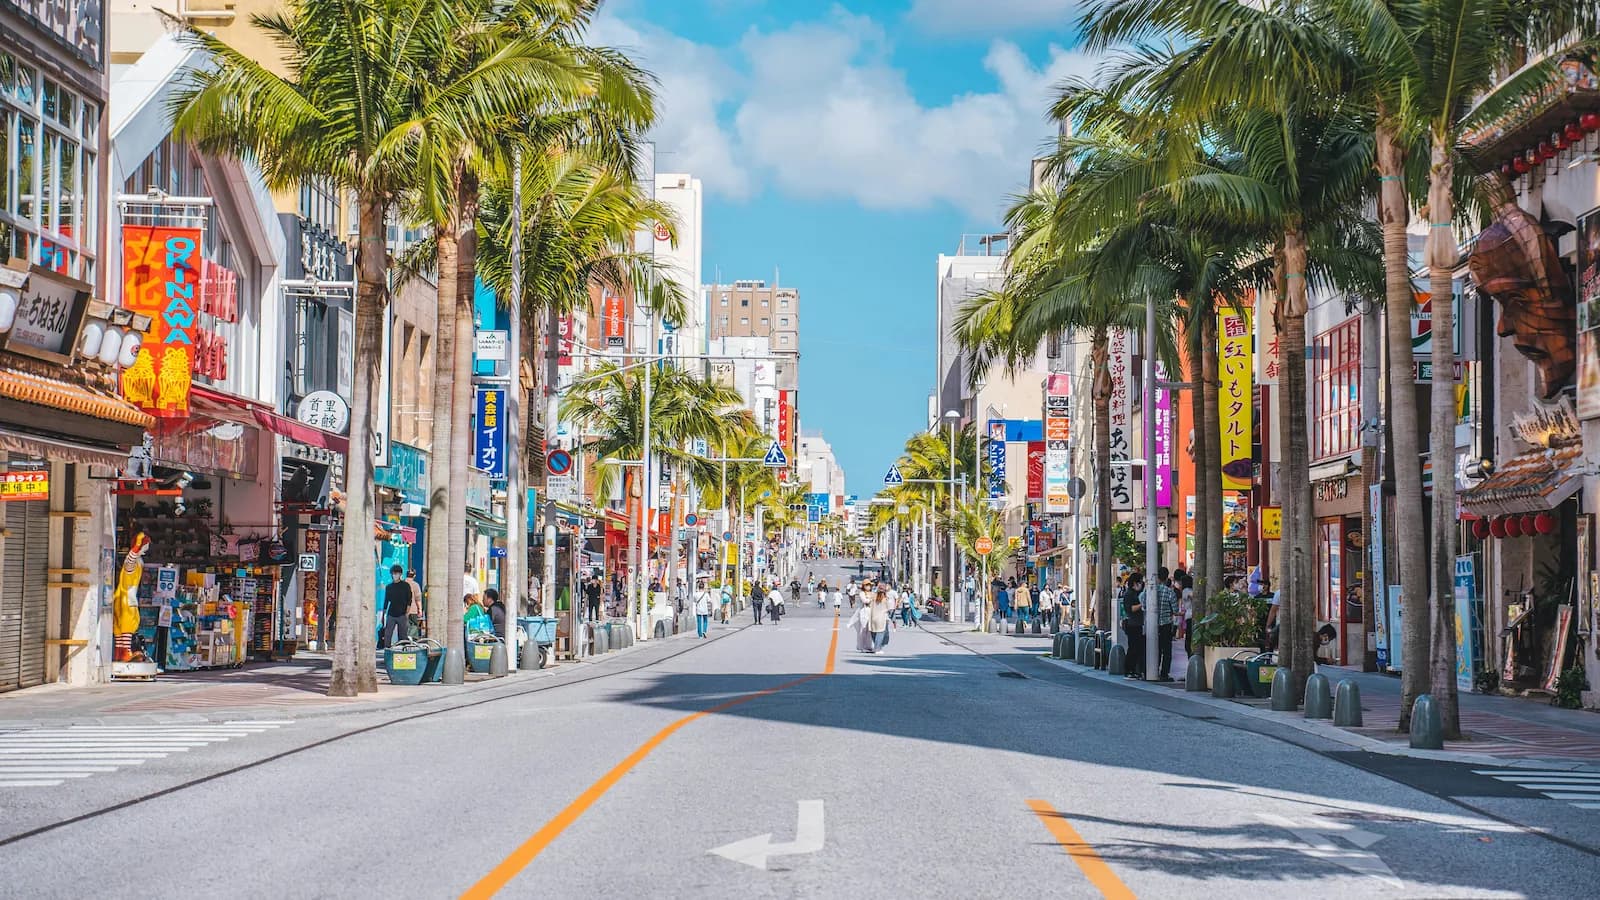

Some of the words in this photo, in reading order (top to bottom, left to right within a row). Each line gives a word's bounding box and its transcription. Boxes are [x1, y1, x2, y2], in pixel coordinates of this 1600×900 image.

[29, 292, 68, 334] ちぬまん
[162, 237, 196, 345] OKINAWA
[1227, 317, 1245, 336] 元祖
[309, 396, 337, 413] 首里
[484, 391, 497, 427] 英会話
[1223, 341, 1247, 458] 紅いもタルト
[482, 426, 498, 472] イーオン
[1109, 427, 1130, 505] あかはち
